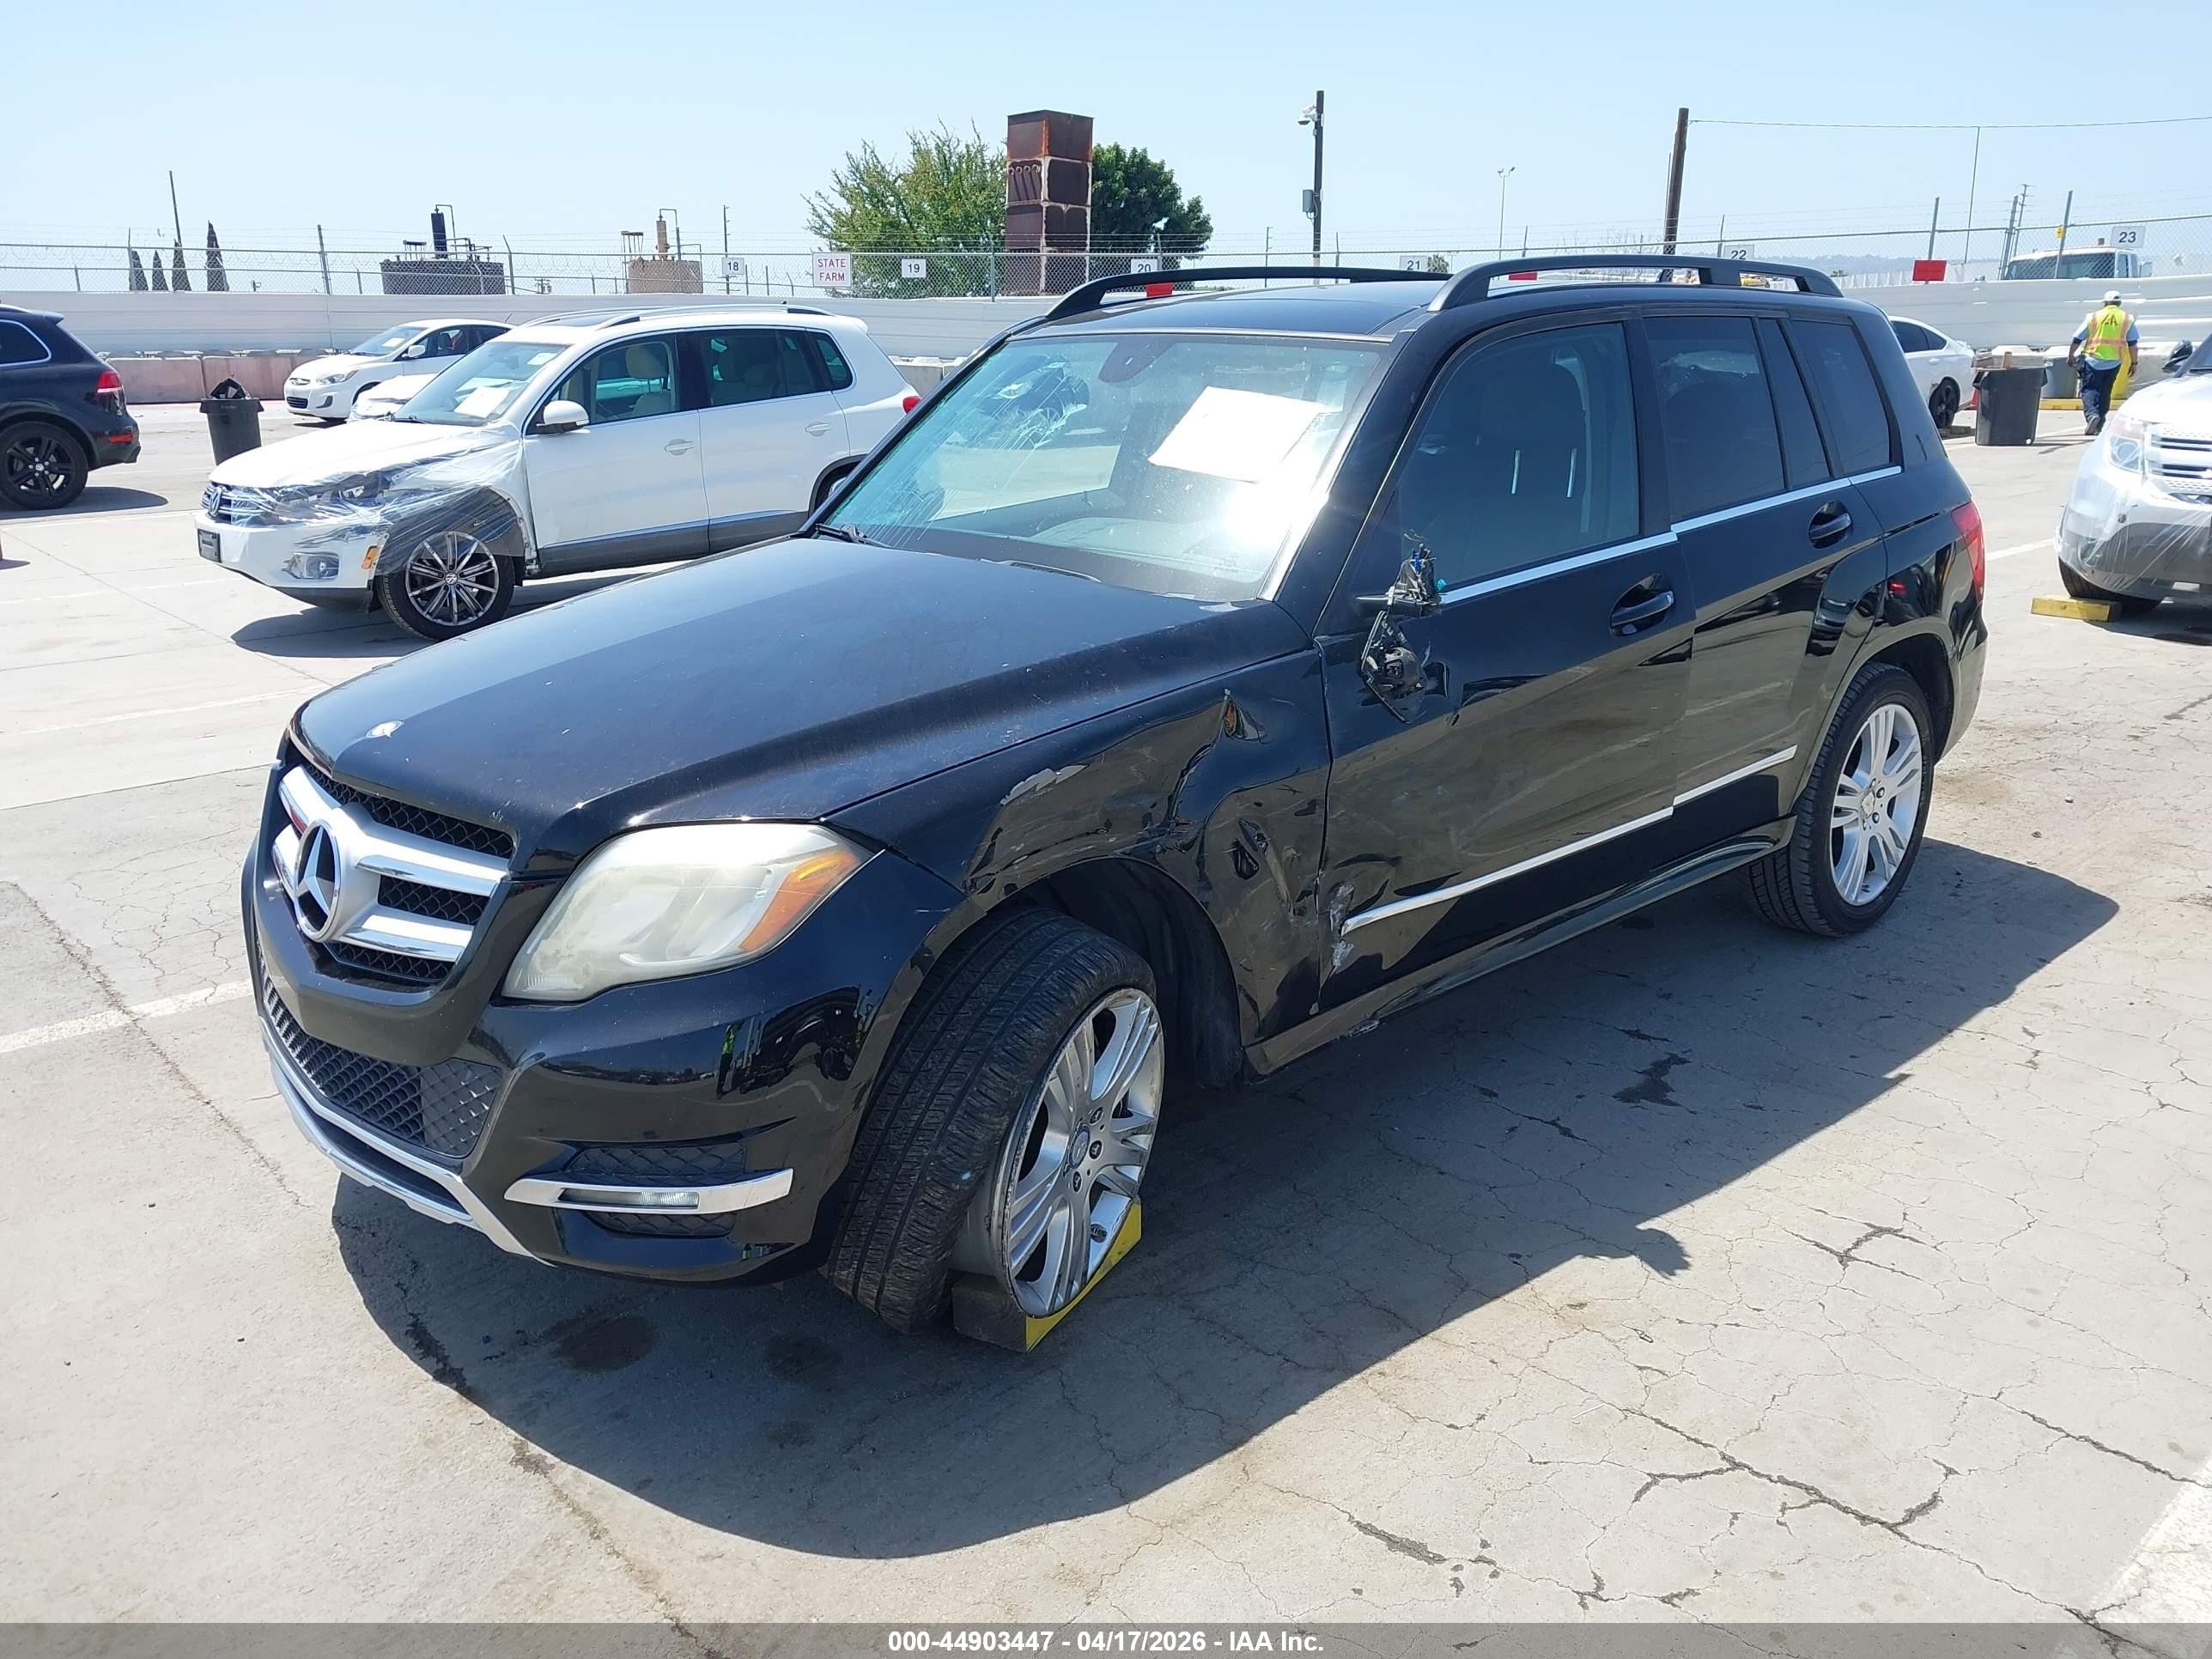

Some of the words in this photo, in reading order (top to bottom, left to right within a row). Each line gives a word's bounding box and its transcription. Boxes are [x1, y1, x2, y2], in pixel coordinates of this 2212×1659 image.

[2118, 231, 2136, 243] 23
[1731, 249, 1747, 260] 22
[727, 261, 738, 270] 18
[817, 258, 846, 267] STATE
[1407, 259, 1420, 270] 21
[908, 263, 920, 273] 19
[1137, 263, 1152, 273] 20
[819, 272, 845, 282] FARM
